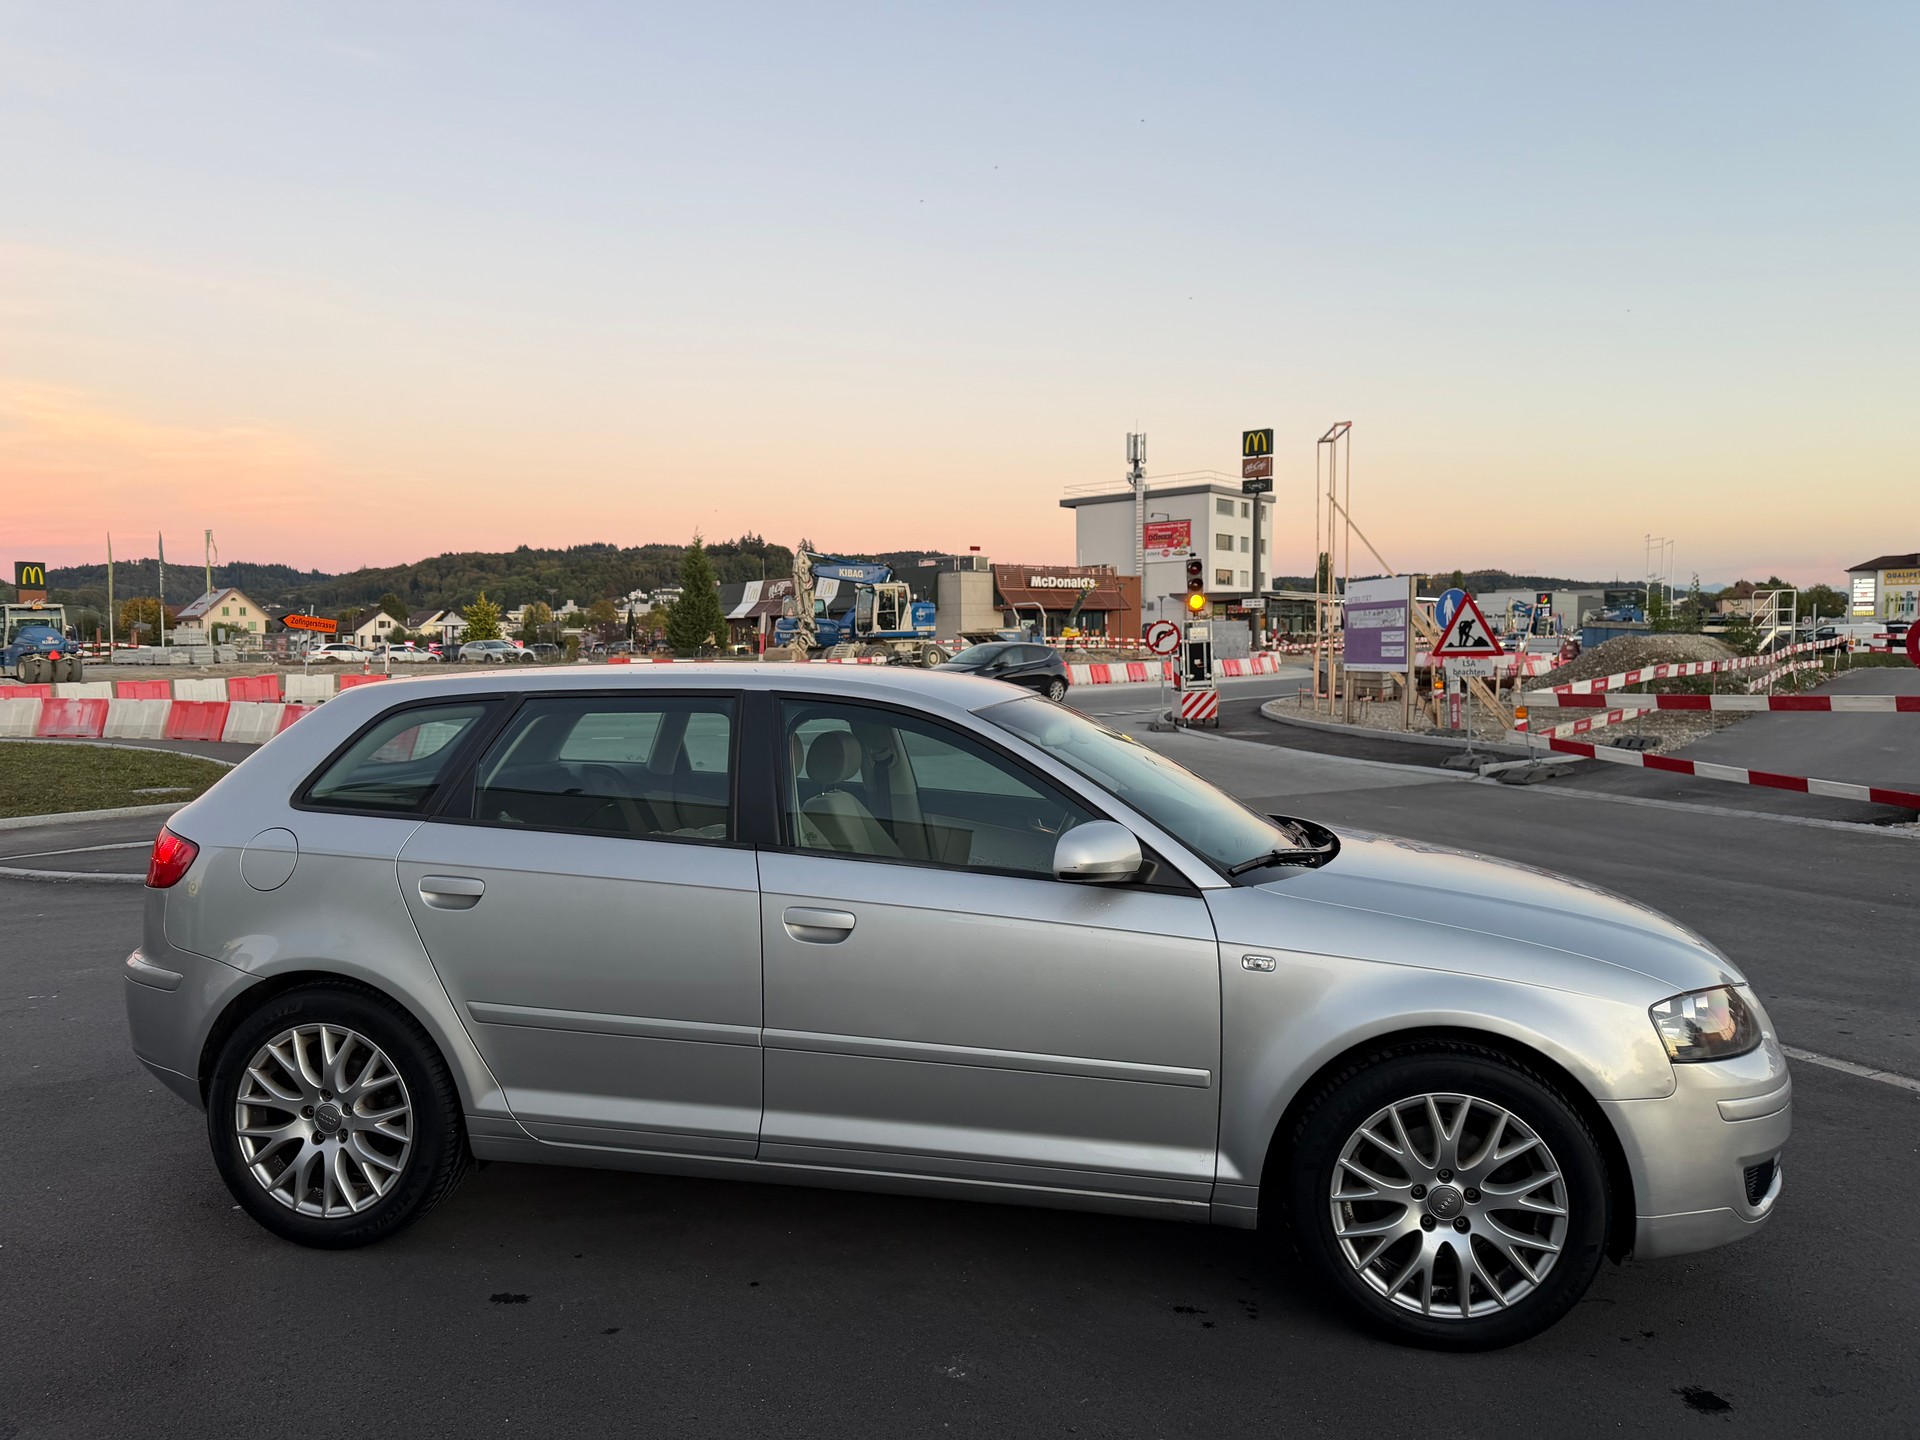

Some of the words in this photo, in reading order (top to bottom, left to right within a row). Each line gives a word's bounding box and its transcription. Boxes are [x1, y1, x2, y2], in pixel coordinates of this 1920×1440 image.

[839, 568, 864, 578] KIBAG
[1030, 576, 1095, 588] McDonald's
[290, 616, 336, 630] Zofingerstrasse
[1453, 668, 1486, 677] beachten
